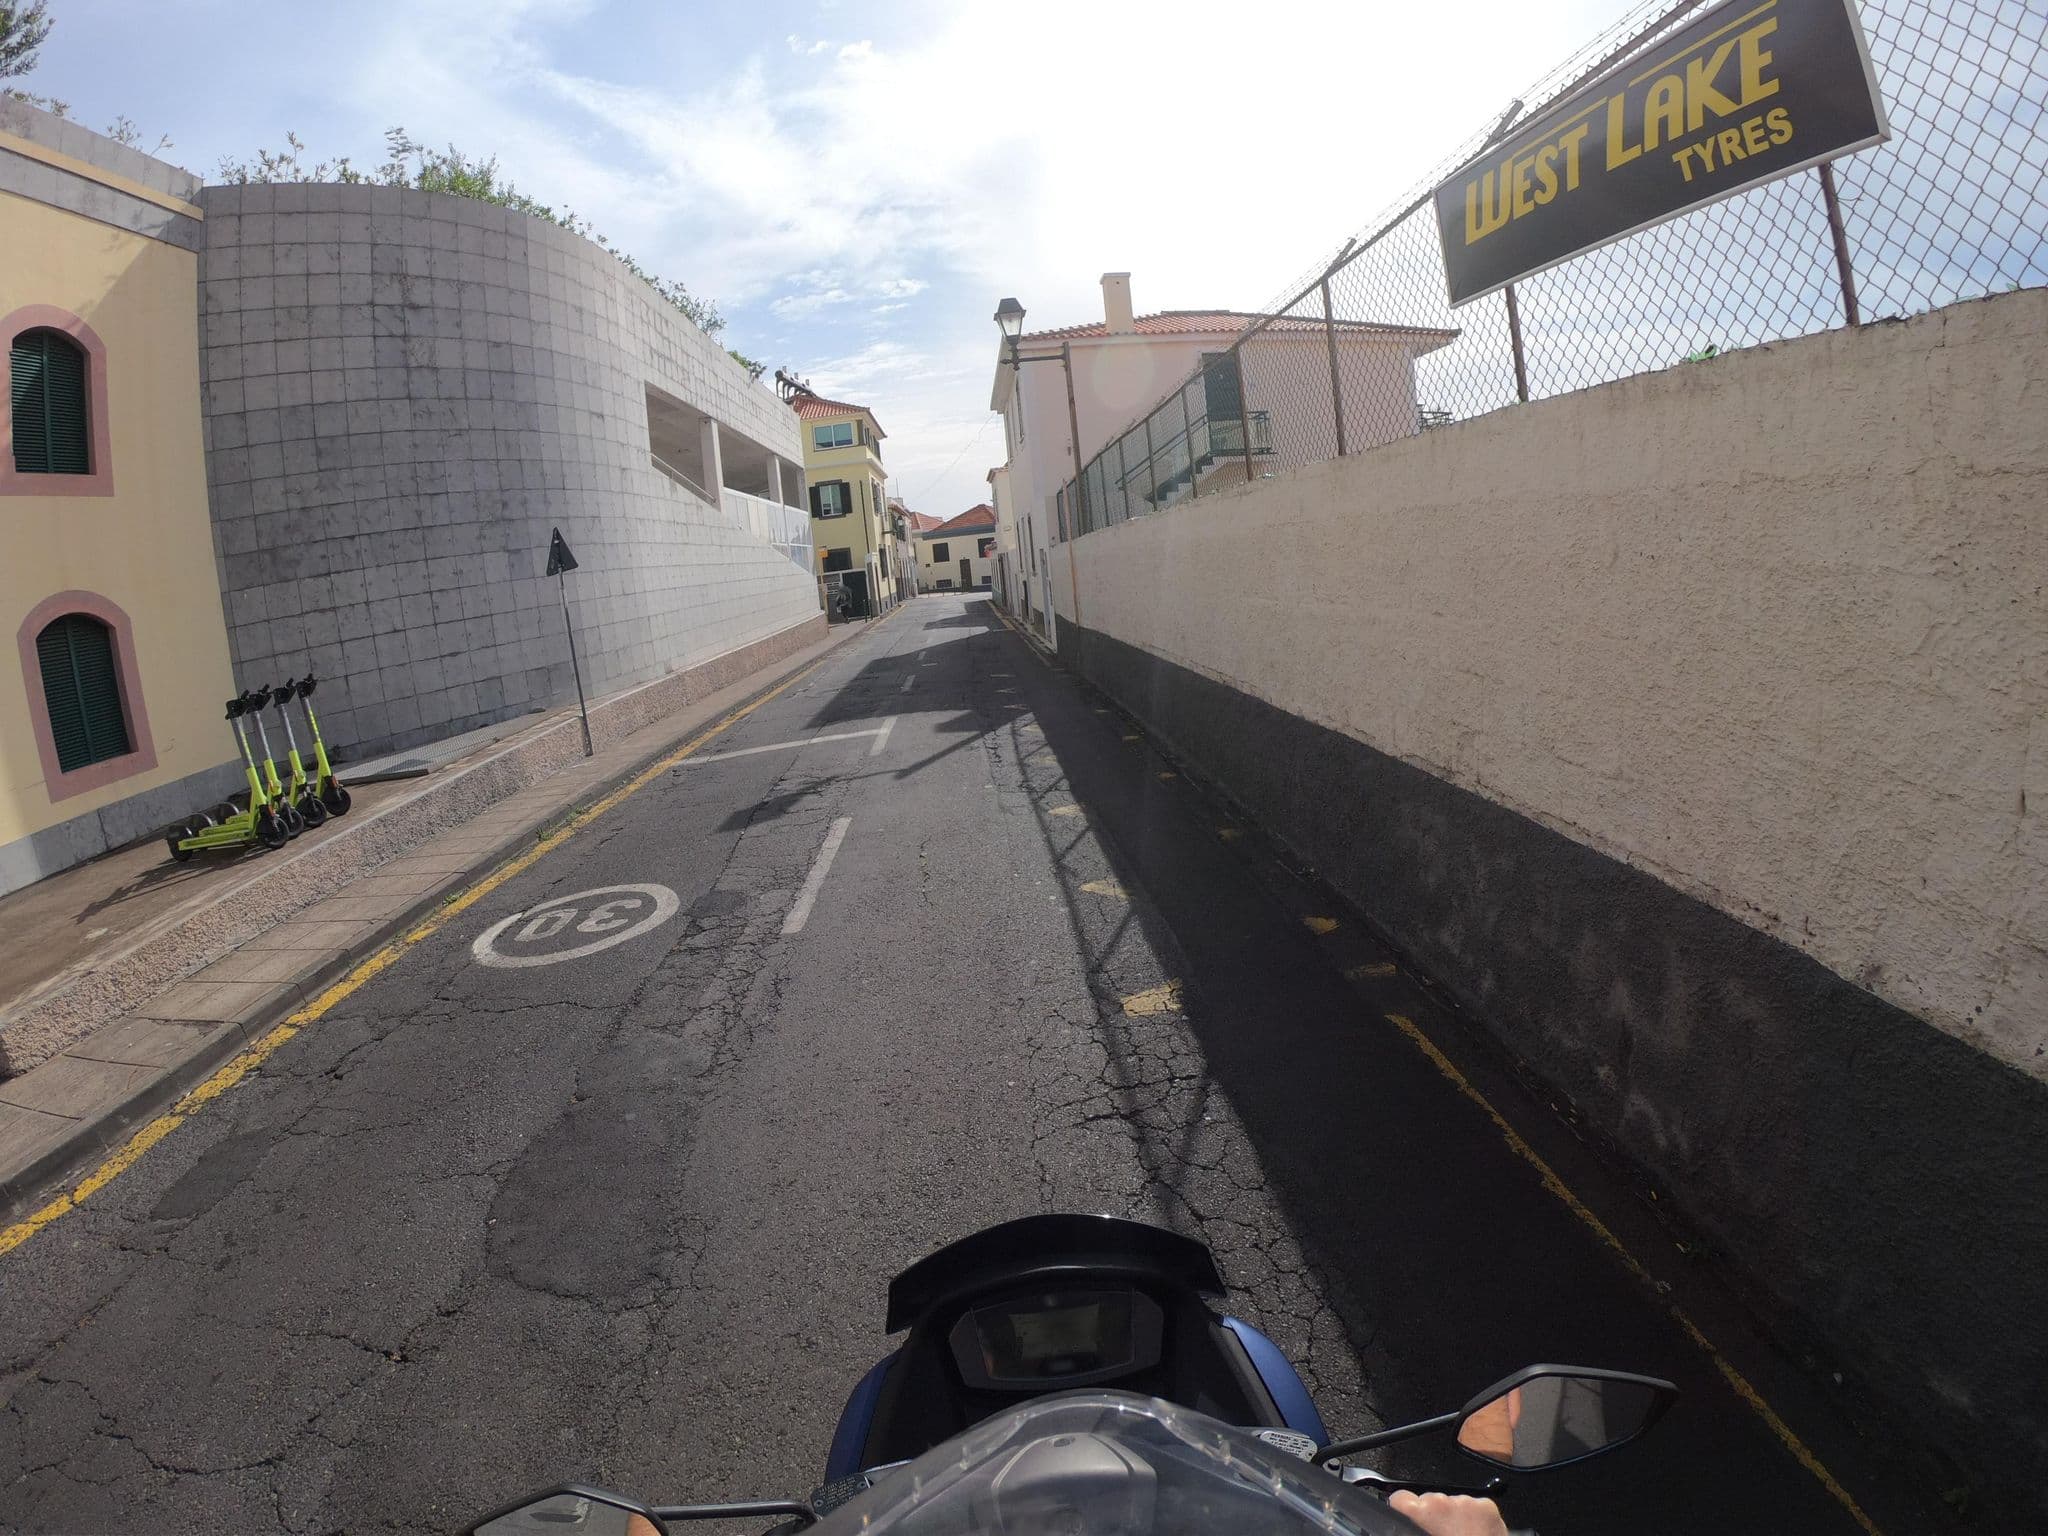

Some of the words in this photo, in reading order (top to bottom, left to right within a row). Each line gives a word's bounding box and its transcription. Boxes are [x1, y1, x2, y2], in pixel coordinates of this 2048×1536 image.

[1465, 124, 1588, 246] WEST
[1606, 18, 1780, 171] LAKE
[1672, 109, 1793, 182] TYRES
[515, 899, 642, 942] 30
